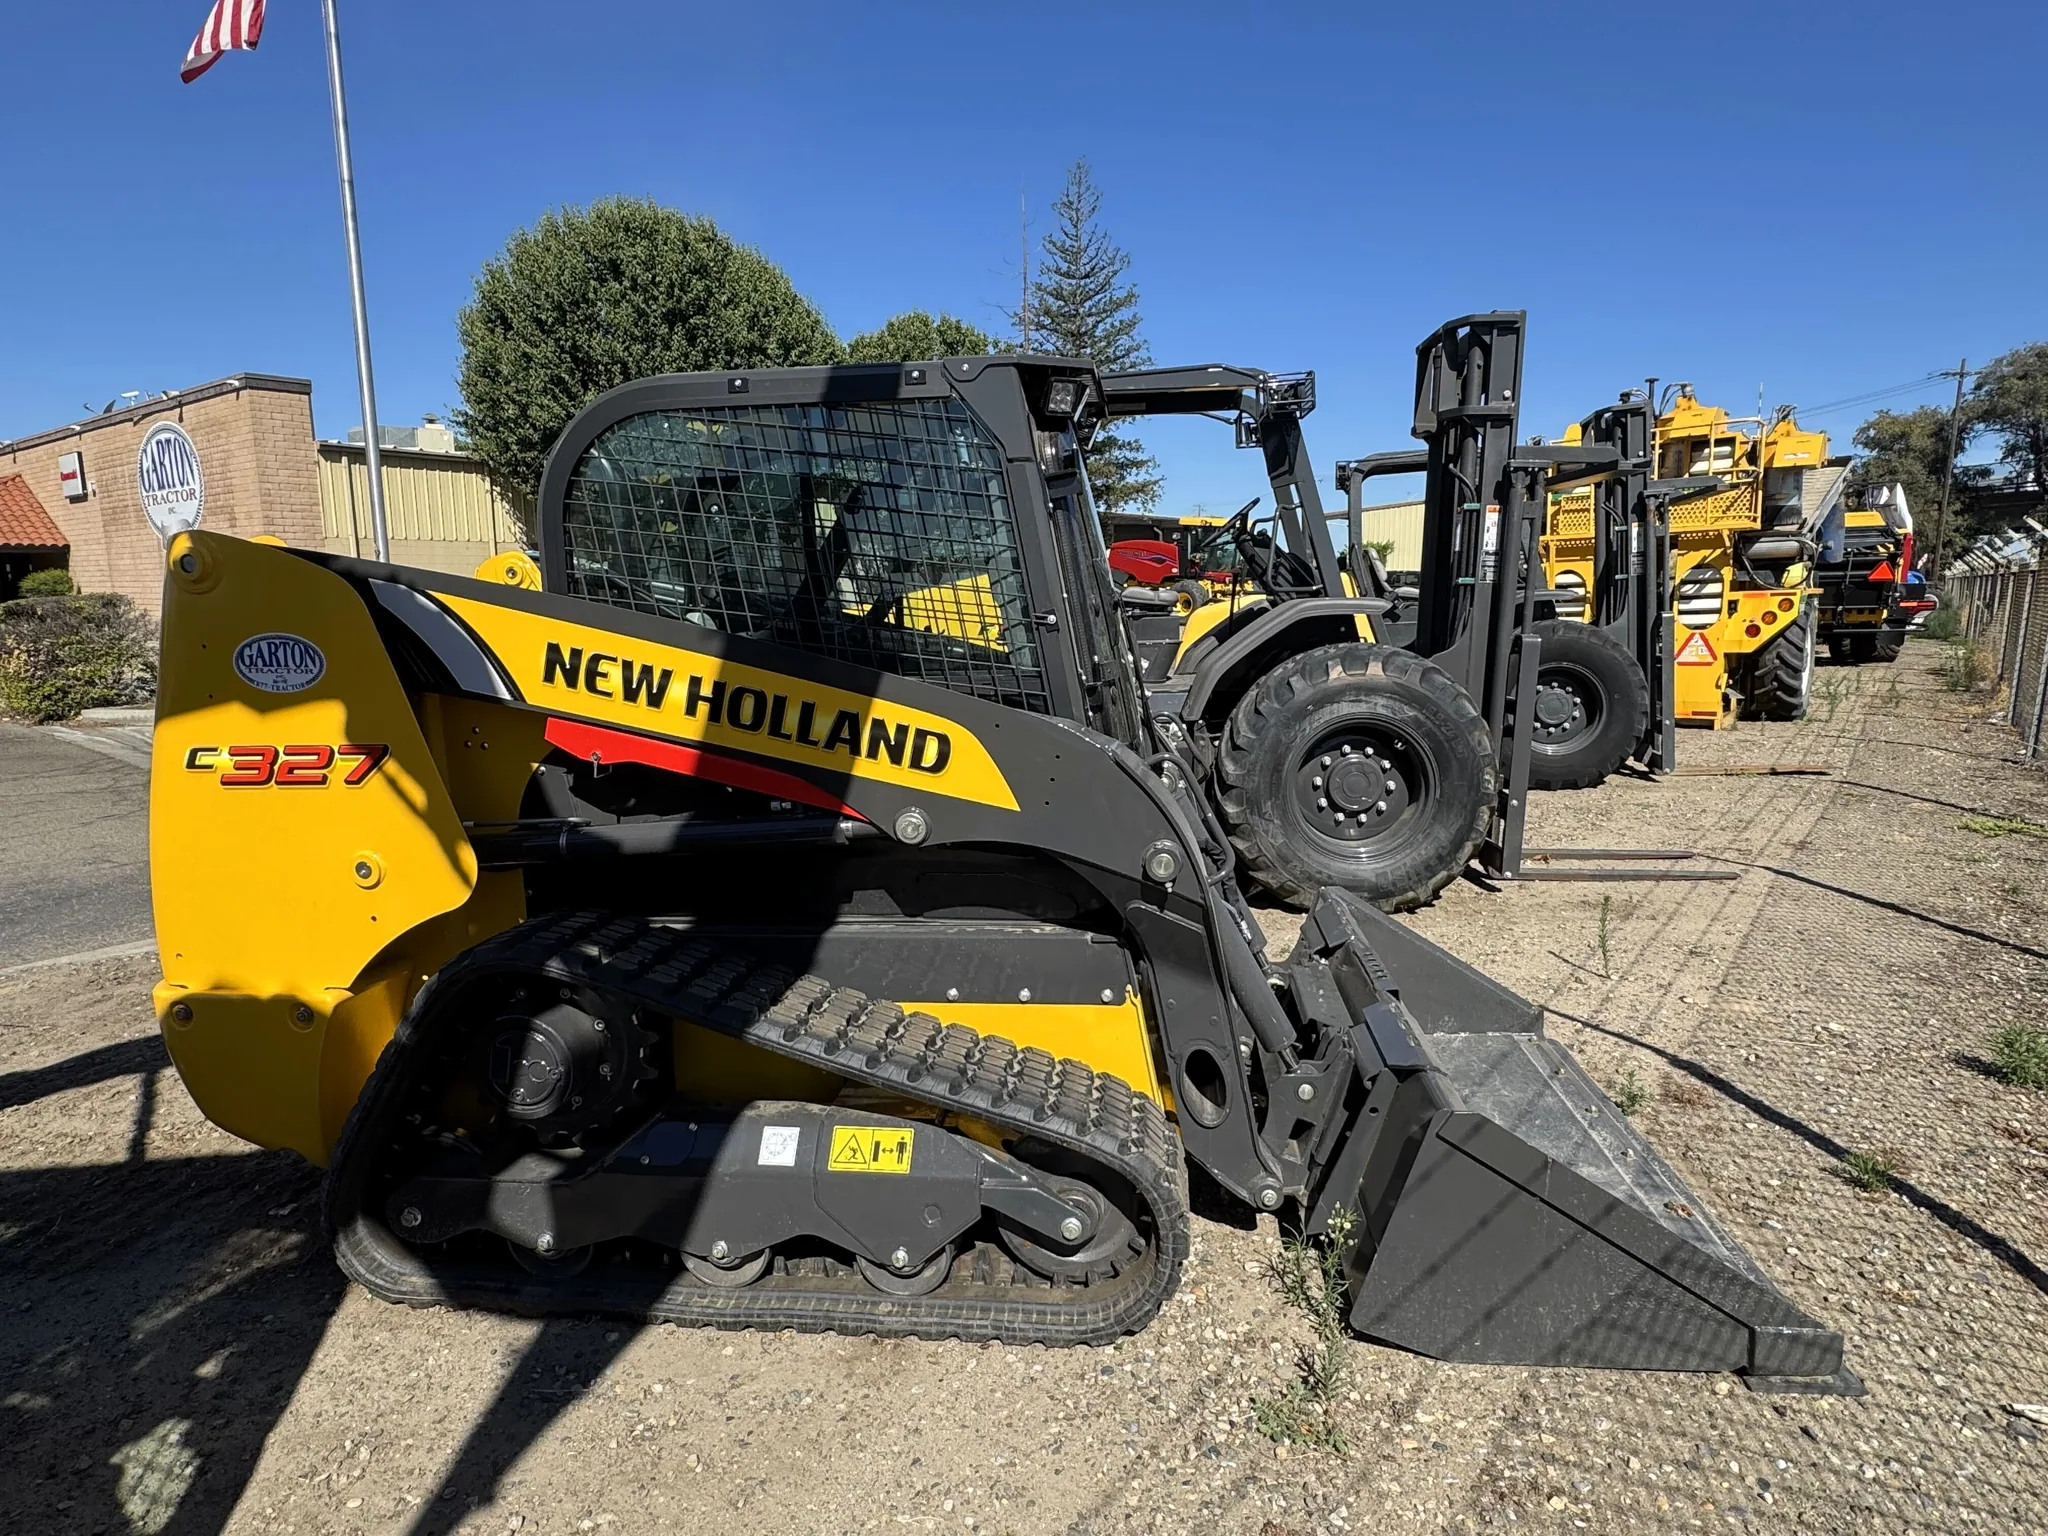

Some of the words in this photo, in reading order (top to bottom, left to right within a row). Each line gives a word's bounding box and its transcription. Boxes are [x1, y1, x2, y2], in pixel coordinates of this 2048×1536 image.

[141, 436, 197, 493] GARTON
[145, 488, 198, 507] TRACTOR
[238, 640, 317, 669] GARTON
[244, 667, 315, 675] TRACTOR
[543, 640, 676, 711] NEW
[684, 673, 953, 776] HOLLAND
